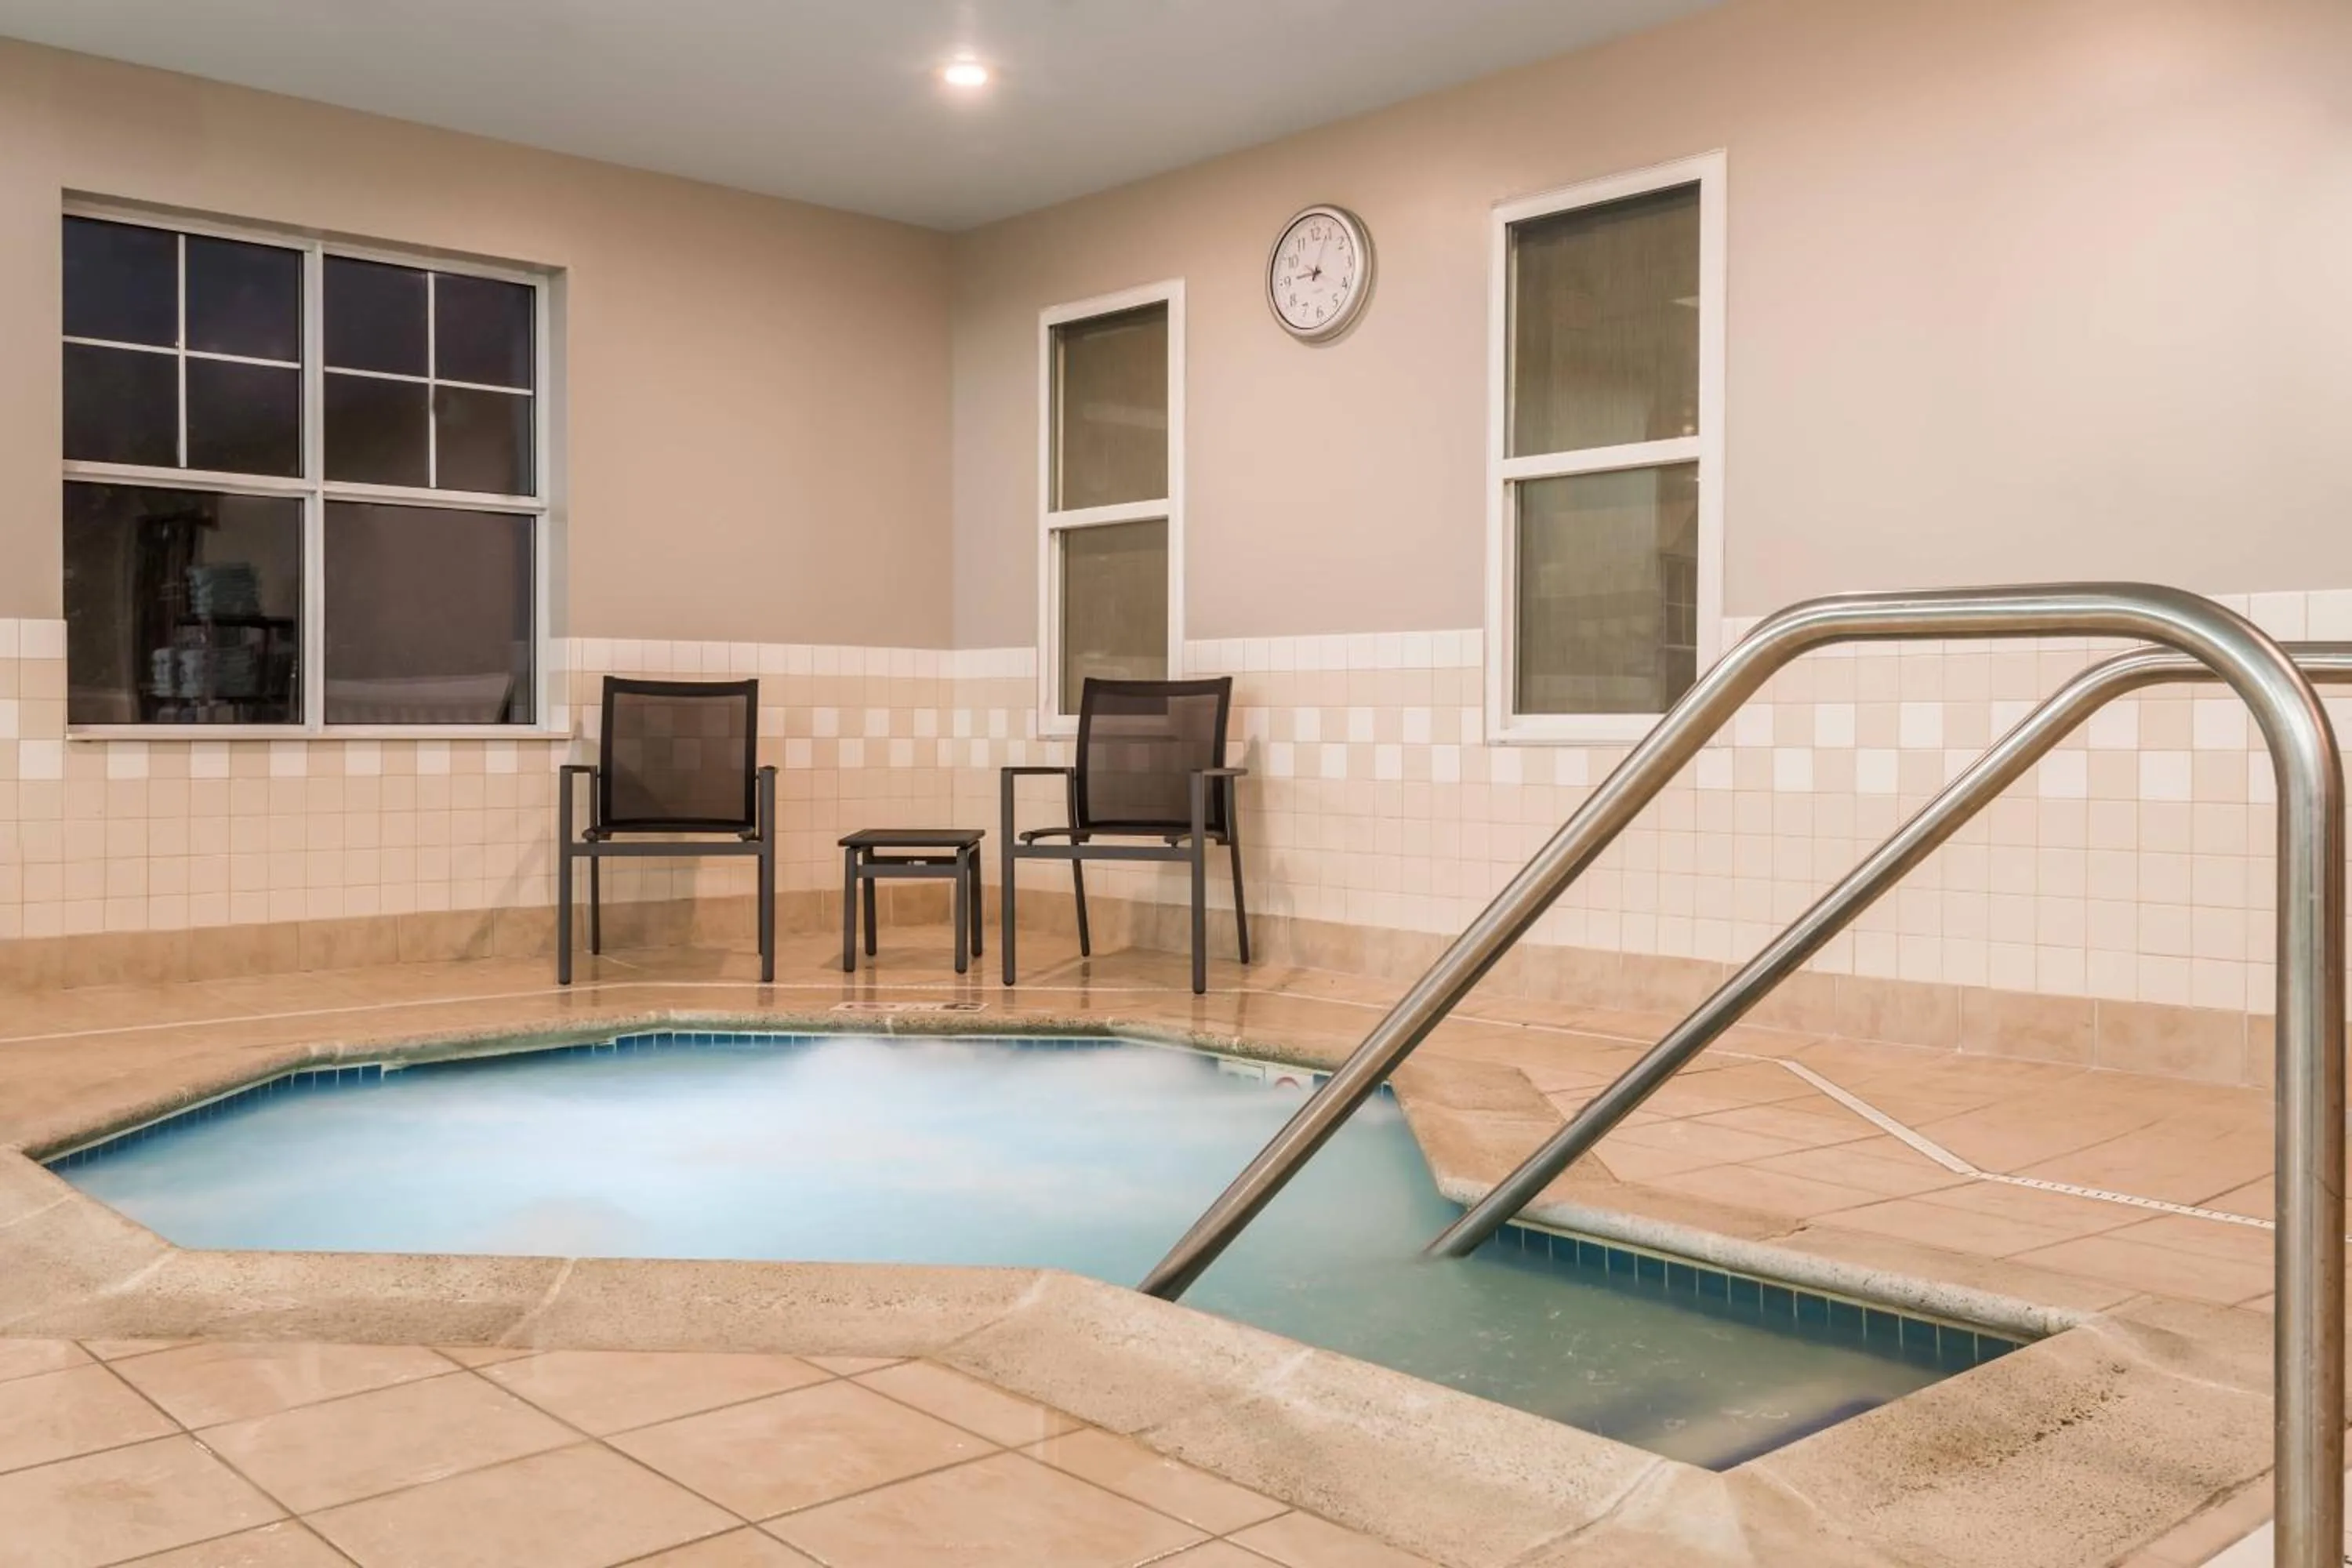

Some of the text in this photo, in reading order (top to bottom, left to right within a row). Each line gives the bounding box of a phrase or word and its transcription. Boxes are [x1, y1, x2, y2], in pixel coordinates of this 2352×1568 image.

[1311, 227, 1321, 241] 12
[1298, 238, 1306, 252] 11
[1338, 236, 1345, 250] 2
[1288, 254, 1298, 268] 10
[1284, 277, 1291, 288] 9
[1342, 277, 1348, 289] 4
[1290, 293, 1298, 307] 8
[1332, 293, 1338, 307] 5
[1316, 307, 1323, 318] 6
